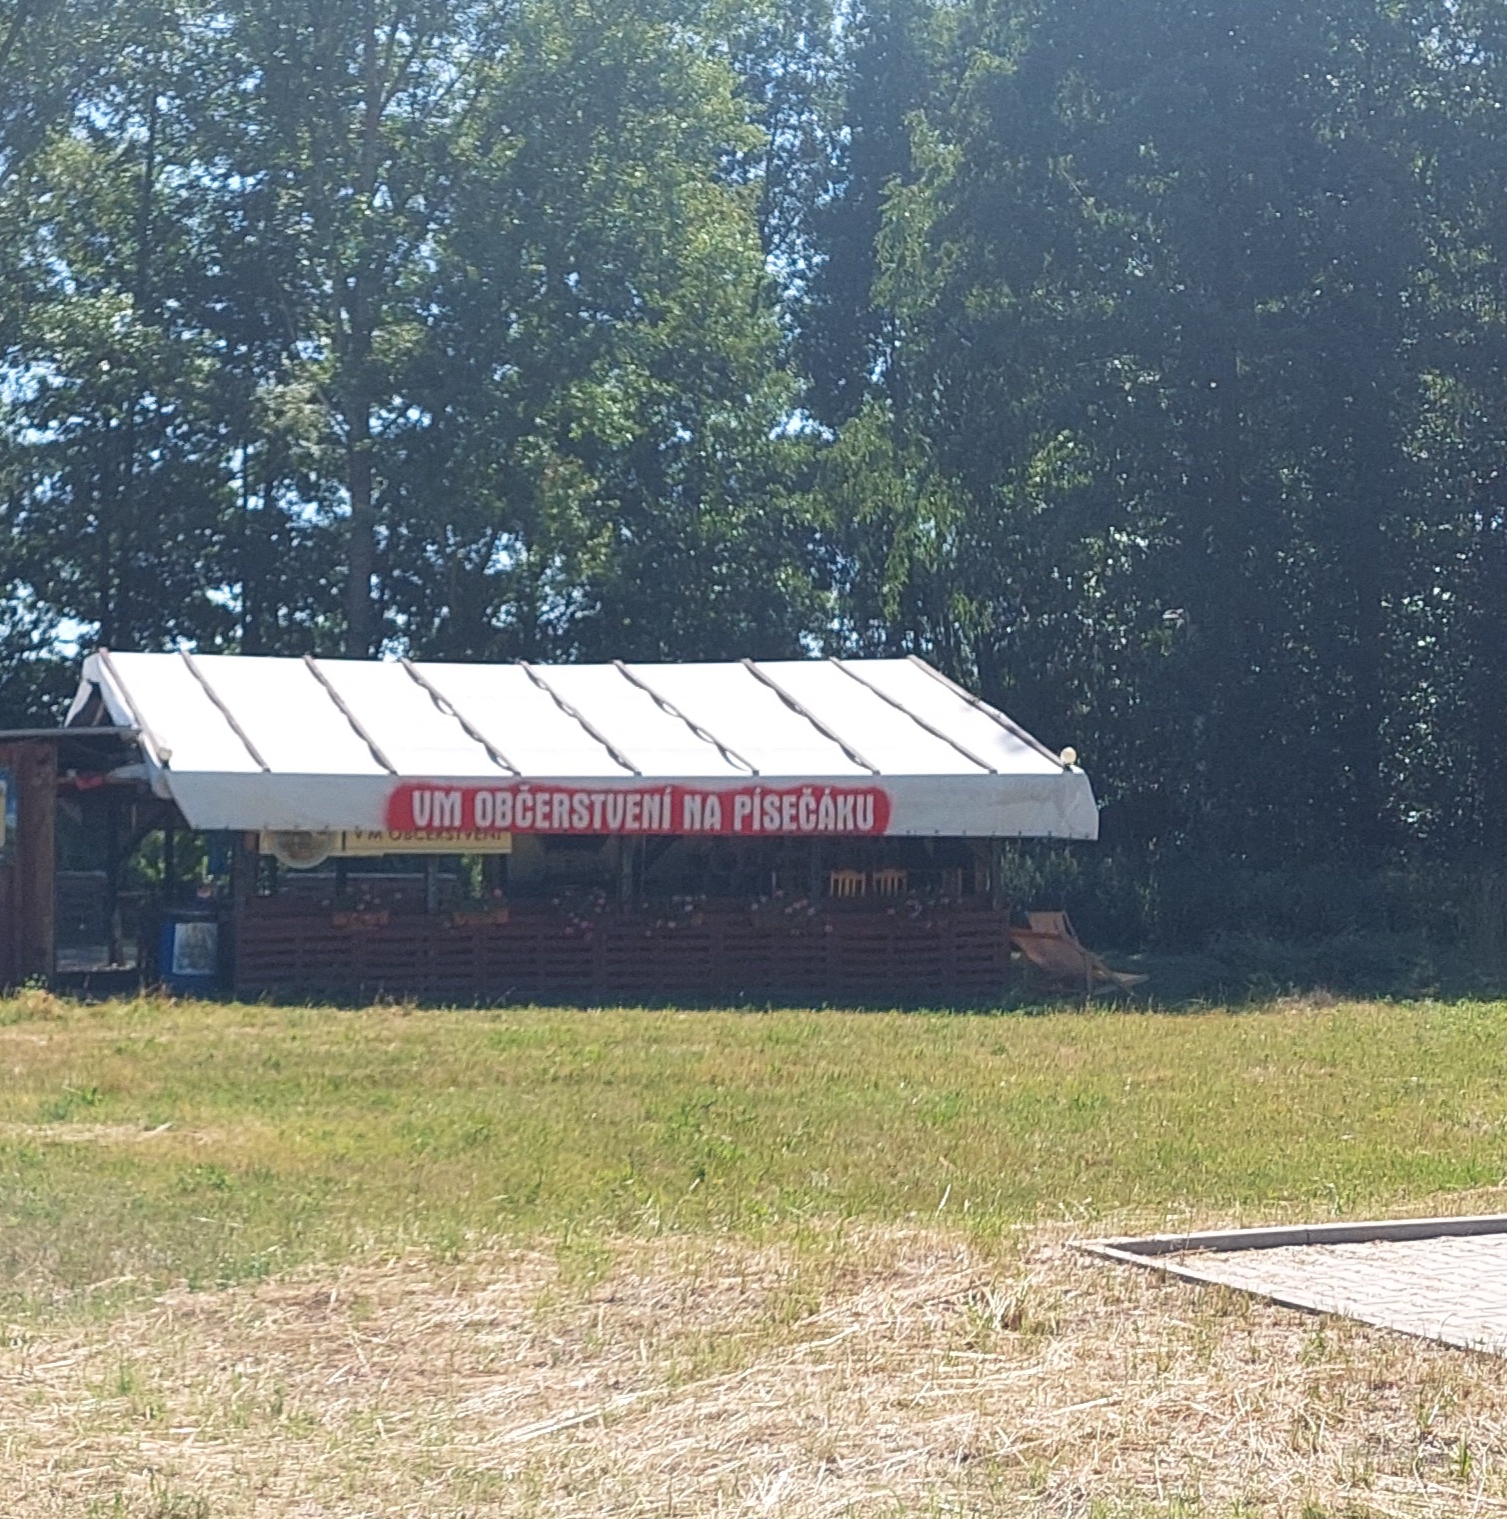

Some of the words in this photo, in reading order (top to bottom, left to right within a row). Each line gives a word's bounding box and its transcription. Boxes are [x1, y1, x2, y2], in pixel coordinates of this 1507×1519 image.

[474, 785, 671, 829] OBČERSTVENÍ
[683, 794, 723, 831] NA
[733, 787, 875, 831] PÍSEČÁKU
